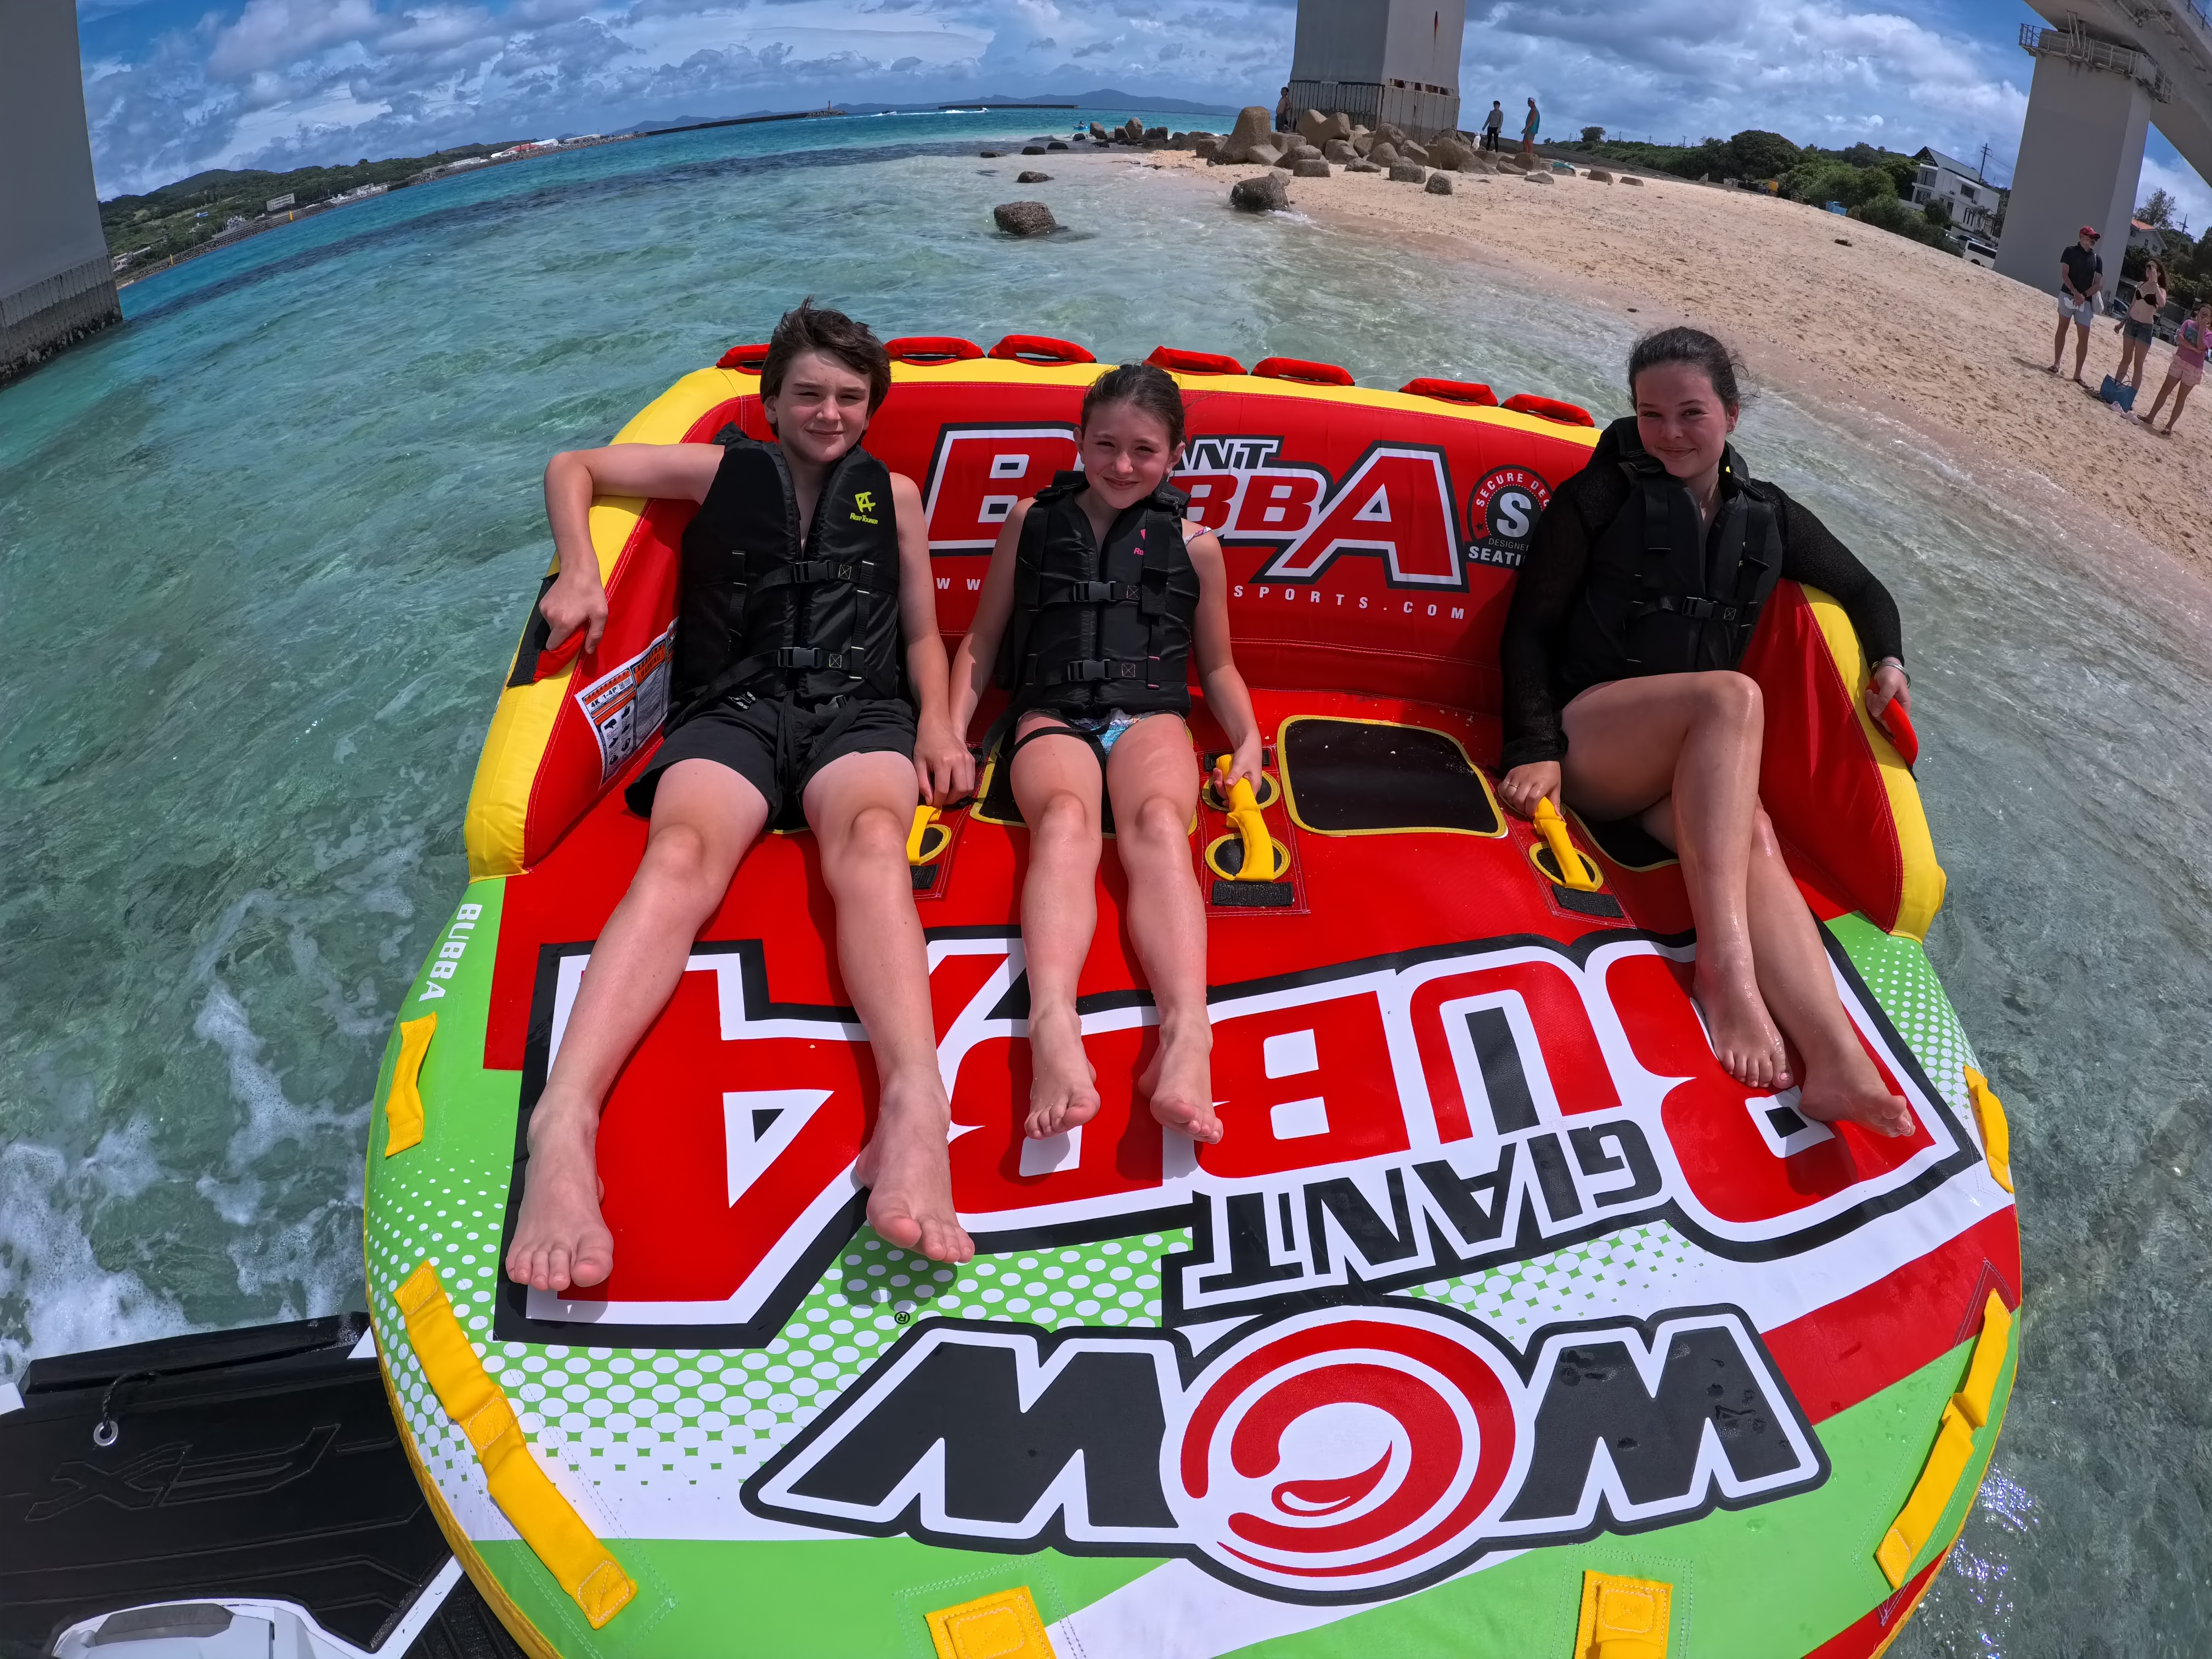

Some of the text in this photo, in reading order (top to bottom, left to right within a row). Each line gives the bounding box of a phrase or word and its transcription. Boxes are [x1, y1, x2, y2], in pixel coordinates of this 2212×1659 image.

[1476, 472, 1551, 508] SECURE DEC
[1468, 545, 1526, 567] SEATI
[418, 903, 483, 1002] BUBBA
[1199, 1118, 1663, 1293] GIANT
[764, 1310, 1816, 1584] WOW
